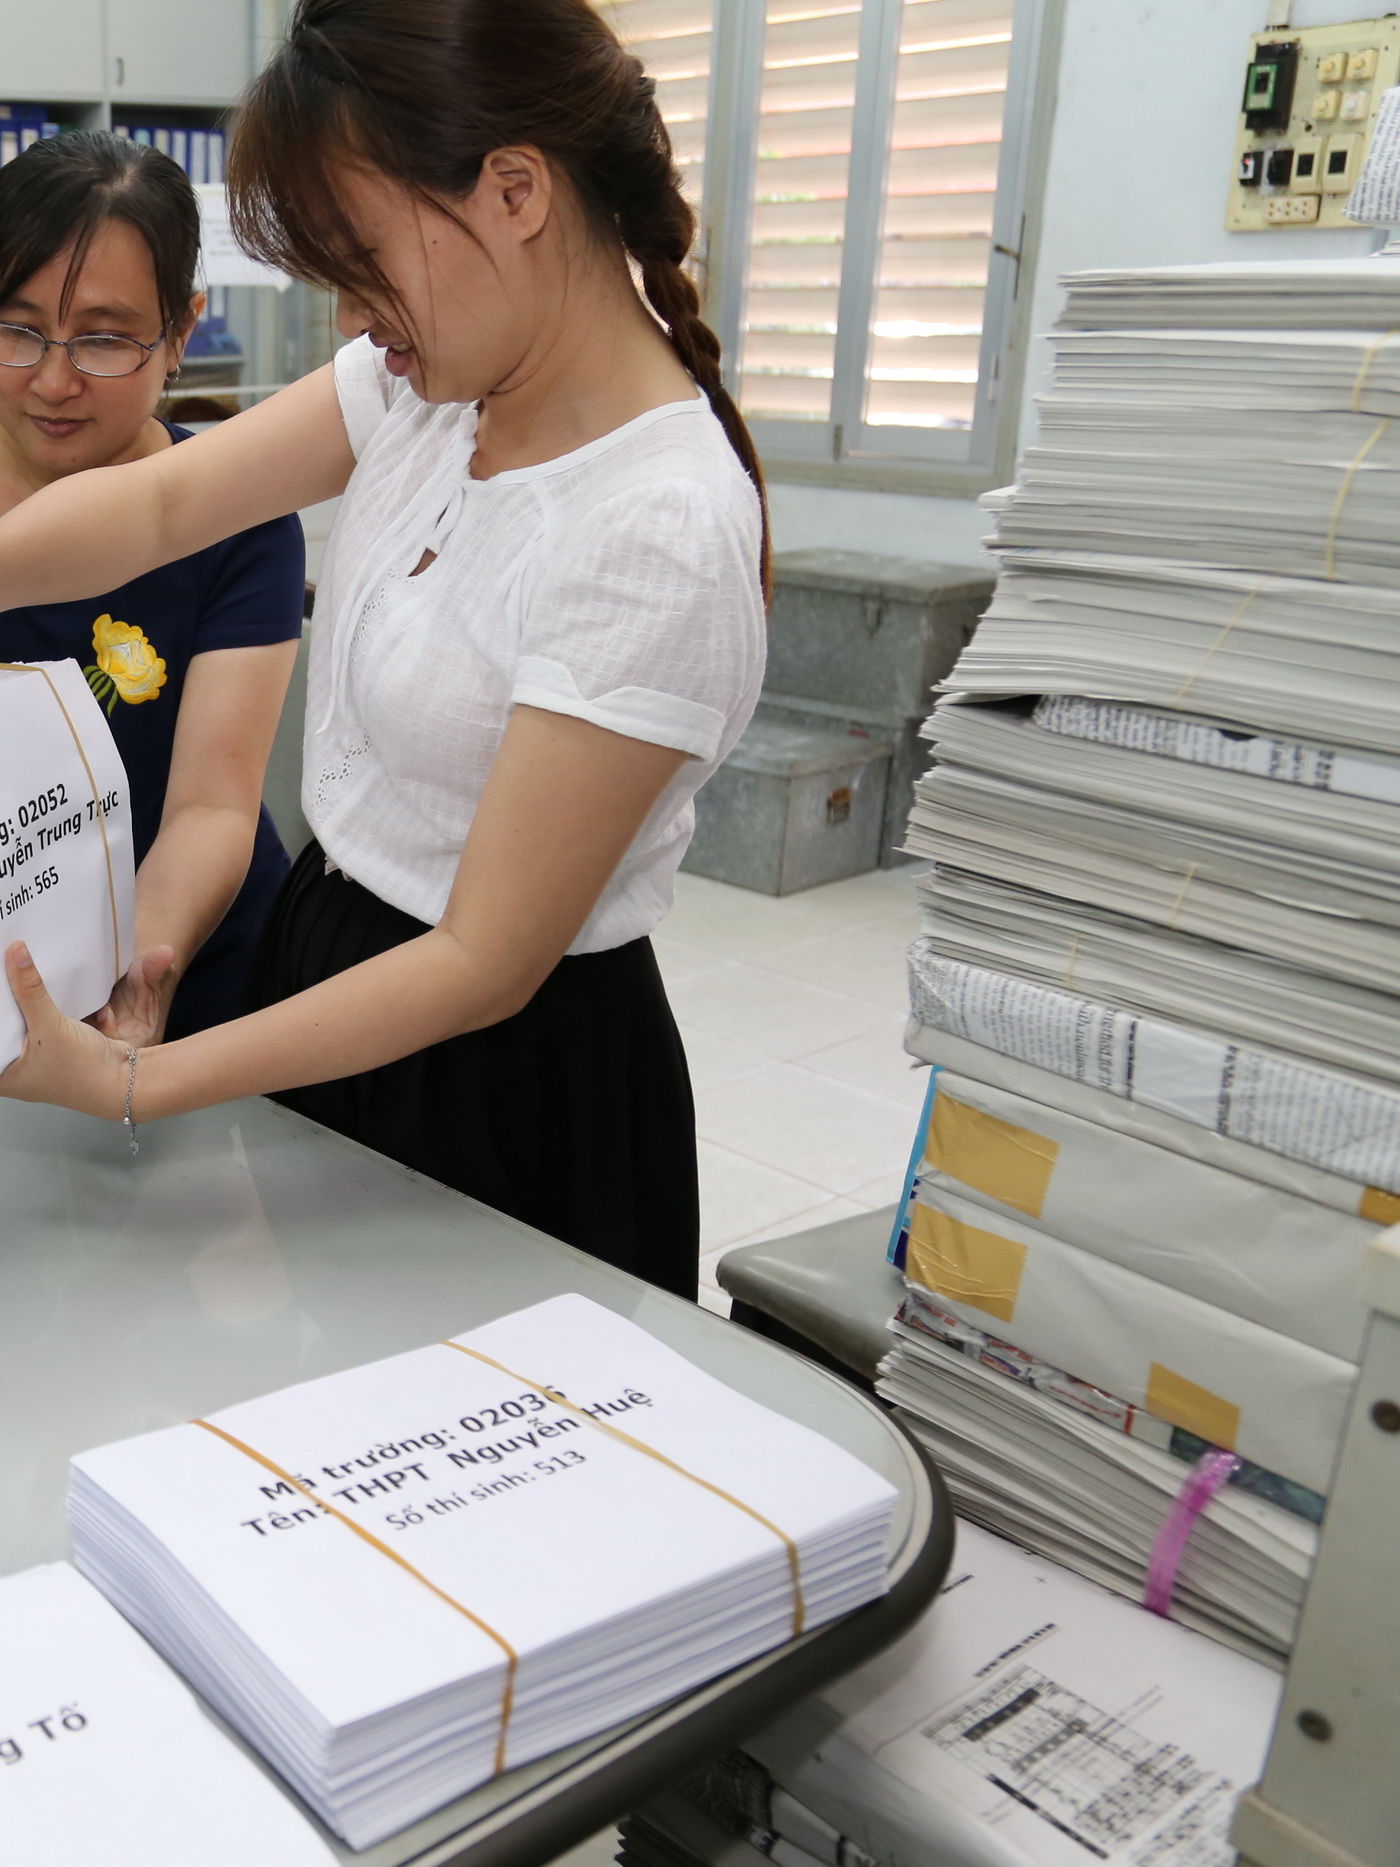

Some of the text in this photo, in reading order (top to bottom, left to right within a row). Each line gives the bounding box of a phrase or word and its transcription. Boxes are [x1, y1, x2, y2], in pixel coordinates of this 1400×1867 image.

[18, 783, 68, 828] 02052
[37, 811, 82, 850] Trung
[86, 790, 119, 820] Trực
[6, 884, 34, 916] sinh:
[34, 866, 59, 895] 565
[241, 1387, 655, 1538] Tên: THPT Nguyễn Huệ
[259, 1475, 318, 1502] Mã
[322, 1427, 457, 1480] trường:
[385, 1449, 588, 1532] Số thí sinh: 513
